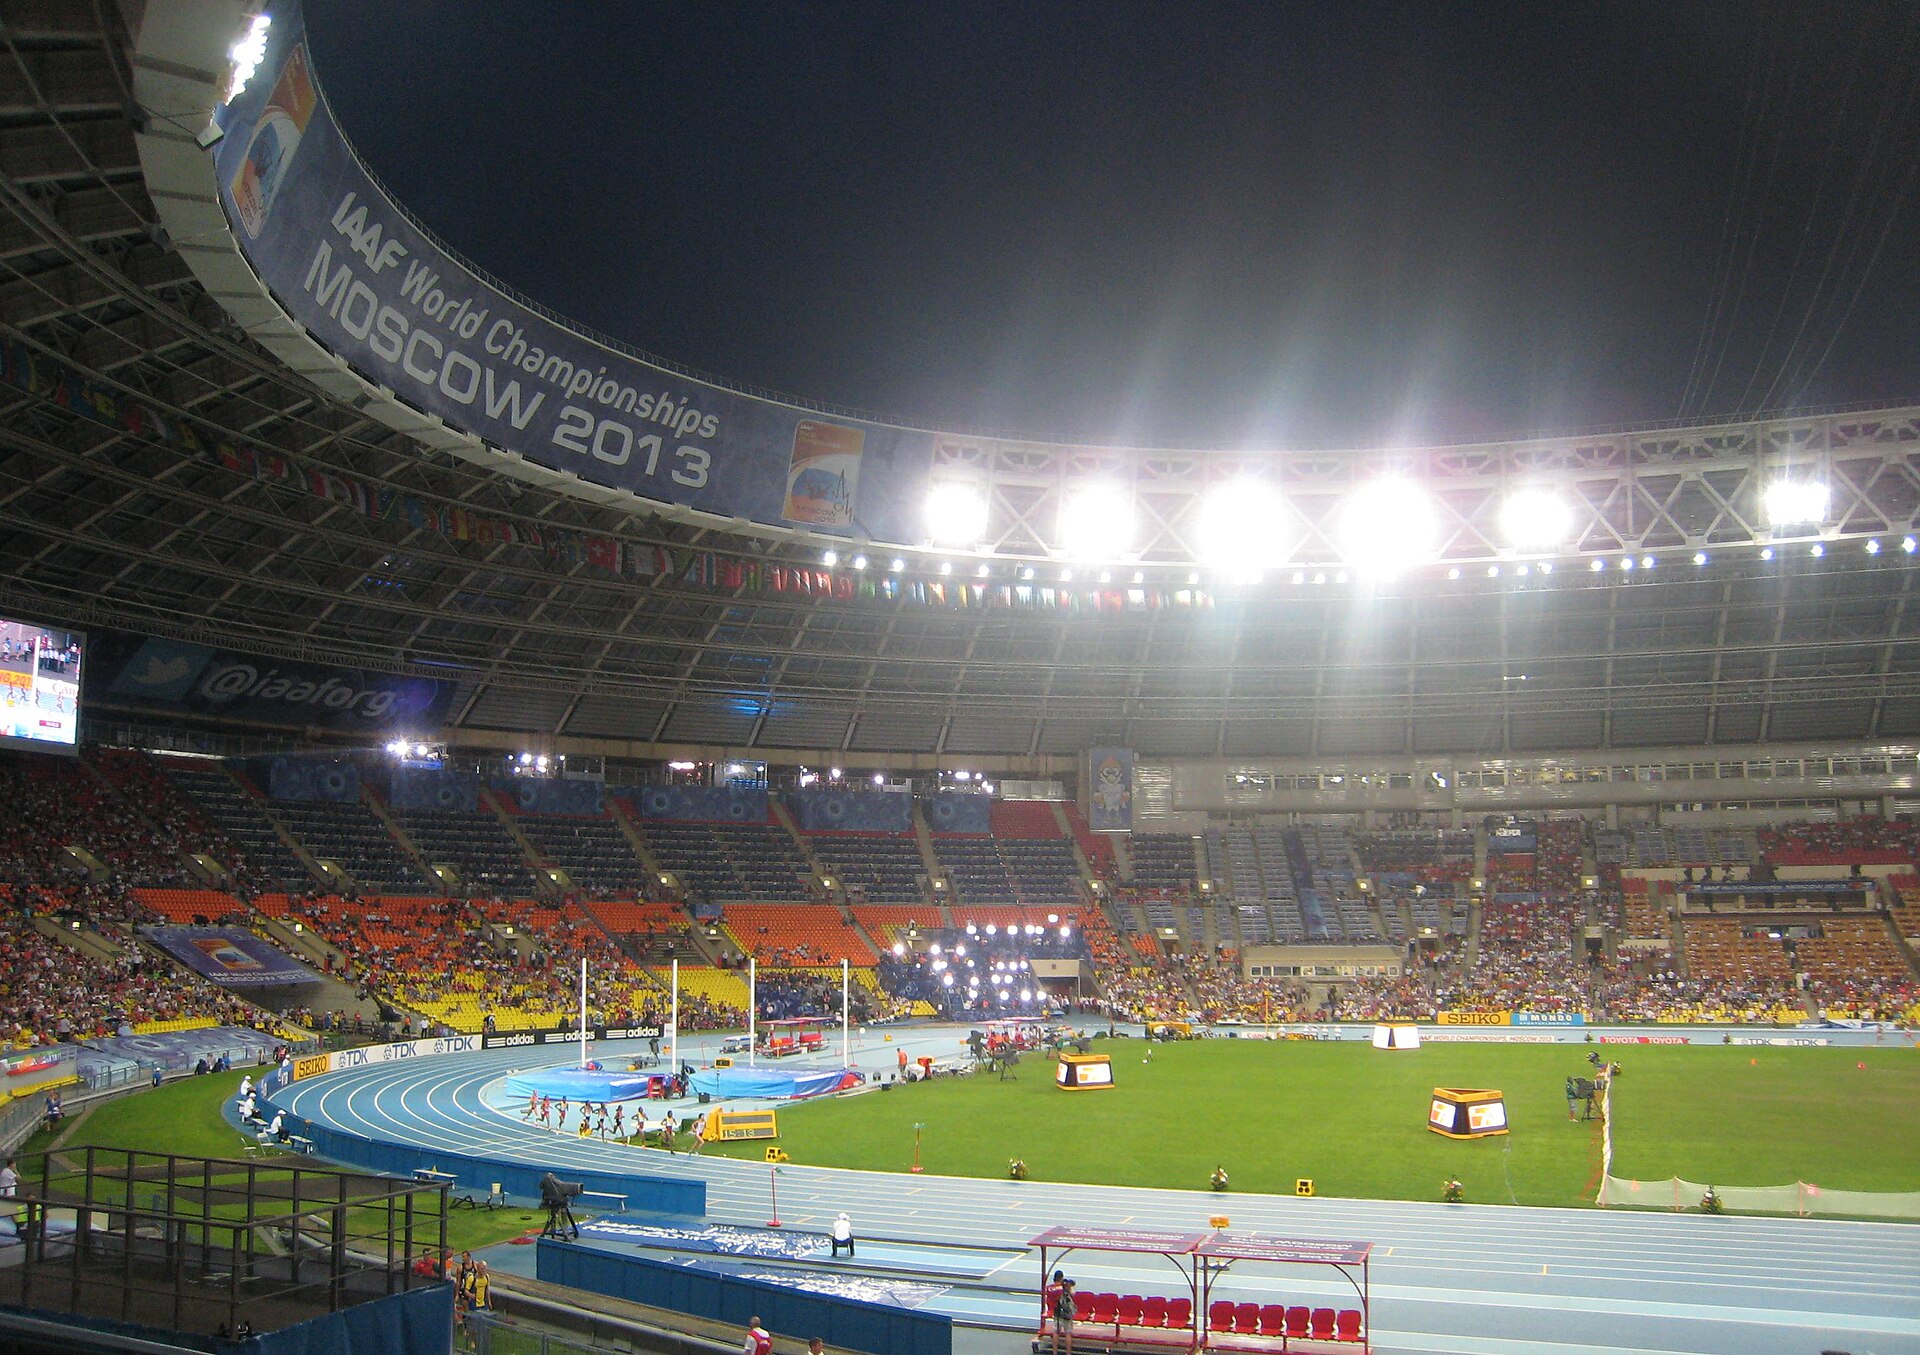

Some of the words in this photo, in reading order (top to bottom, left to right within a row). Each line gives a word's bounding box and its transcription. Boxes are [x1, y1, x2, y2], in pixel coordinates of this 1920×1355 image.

[331, 192, 408, 273] IAAF
[400, 259, 489, 339] World
[485, 319, 719, 439] Championships
[304, 240, 546, 430] MOSCOW
[552, 406, 711, 488] 2013
[201, 664, 398, 717] @iaaforg
[1447, 1013, 1501, 1024] SEIKO
[506, 1033, 535, 1046] adidas
[627, 1026, 660, 1038] adidas
[392, 1042, 417, 1058] TDK
[444, 1036, 474, 1052] TDK
[346, 1048, 369, 1066] TDK
[299, 1057, 328, 1078] SEIKO
